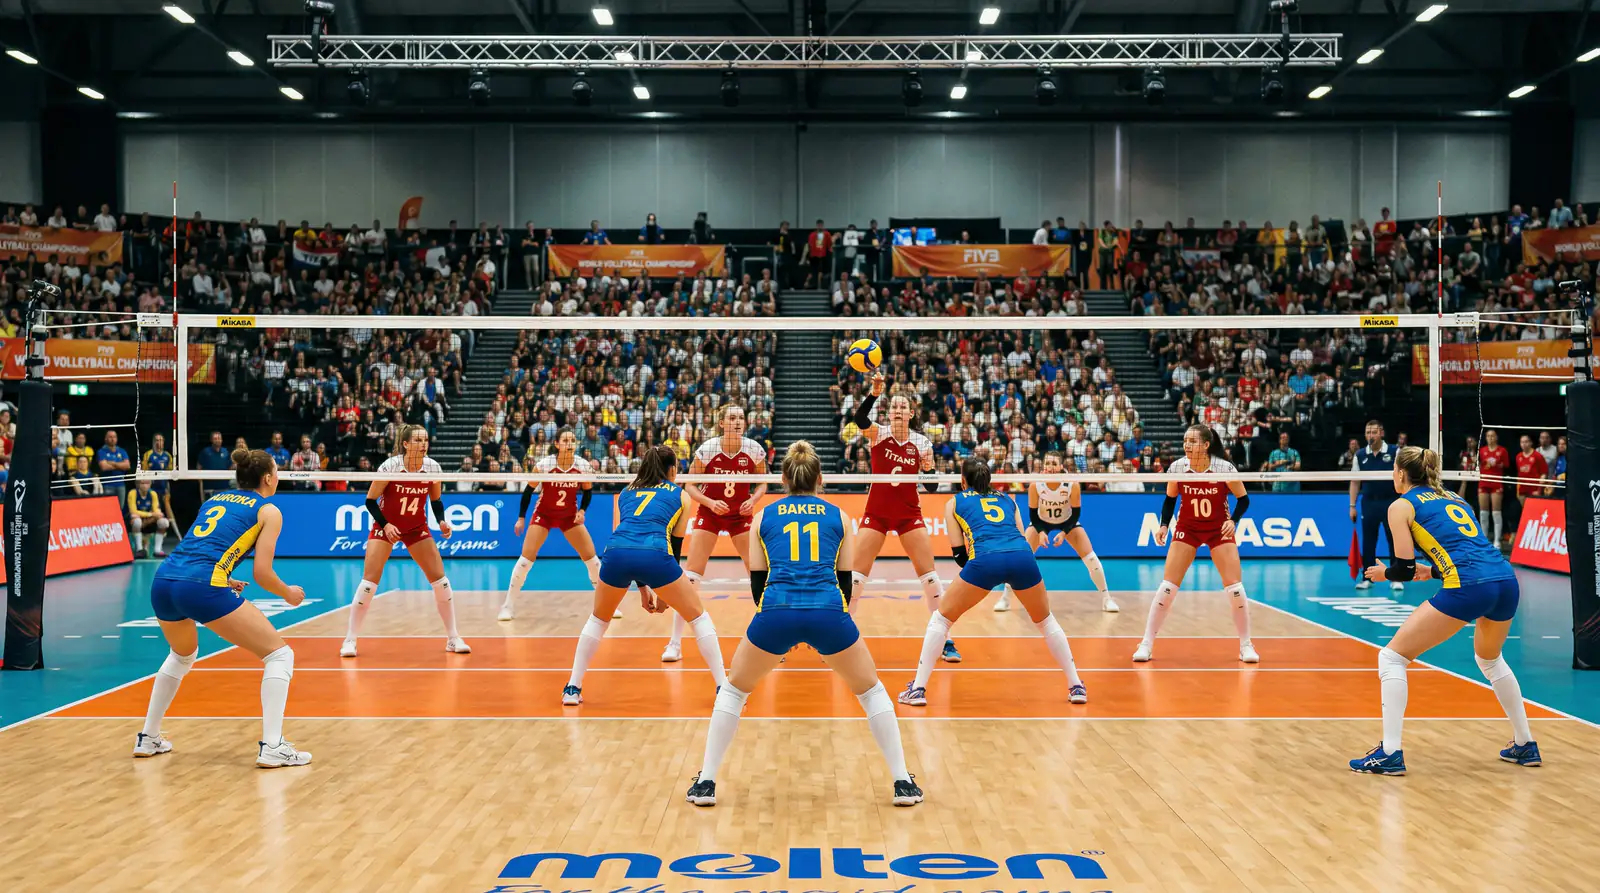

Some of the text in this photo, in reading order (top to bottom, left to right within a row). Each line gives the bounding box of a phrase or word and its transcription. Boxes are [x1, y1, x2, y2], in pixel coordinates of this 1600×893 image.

[963, 248, 1000, 263] FIVB
[54, 356, 114, 369] VOLLEYBALL
[884, 448, 916, 466] TITANS
[395, 484, 428, 494] TITANS
[556, 490, 567, 507] 2
[1183, 485, 1218, 495] TITANS
[400, 497, 420, 516] 14
[633, 491, 656, 517] 7
[777, 504, 826, 515] BAKER
[980, 497, 1005, 522] 5
[1191, 498, 1212, 518] 10
[193, 505, 226, 537] 3
[1445, 504, 1478, 537] 9
[58, 522, 124, 550] CHAMPIONSHIP
[783, 521, 820, 562] 11
[450, 539, 500, 556] game
[497, 848, 1108, 880] molten
